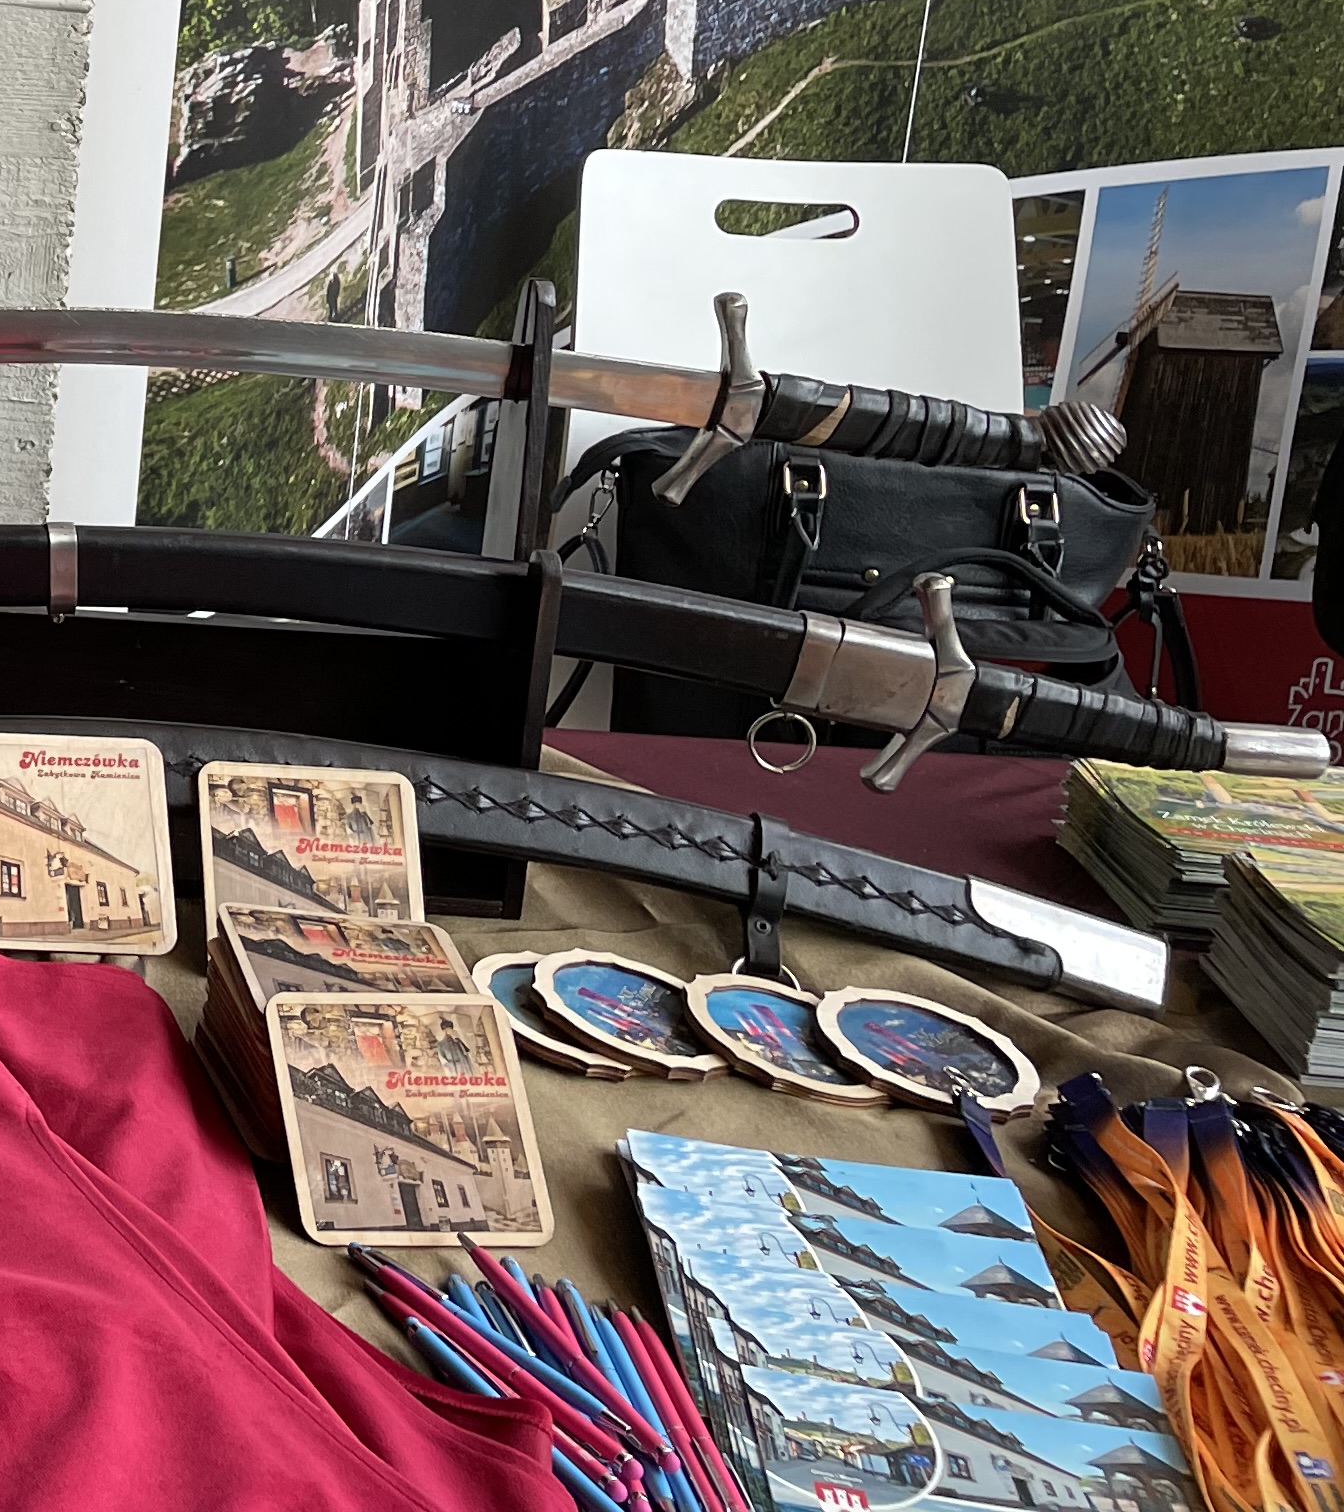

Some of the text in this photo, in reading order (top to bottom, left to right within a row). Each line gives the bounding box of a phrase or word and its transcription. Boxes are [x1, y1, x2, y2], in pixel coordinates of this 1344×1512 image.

[19, 750, 140, 769] Niemczówka
[296, 838, 403, 856] Niemczówka
[386, 1070, 507, 1089] Niemczówka
